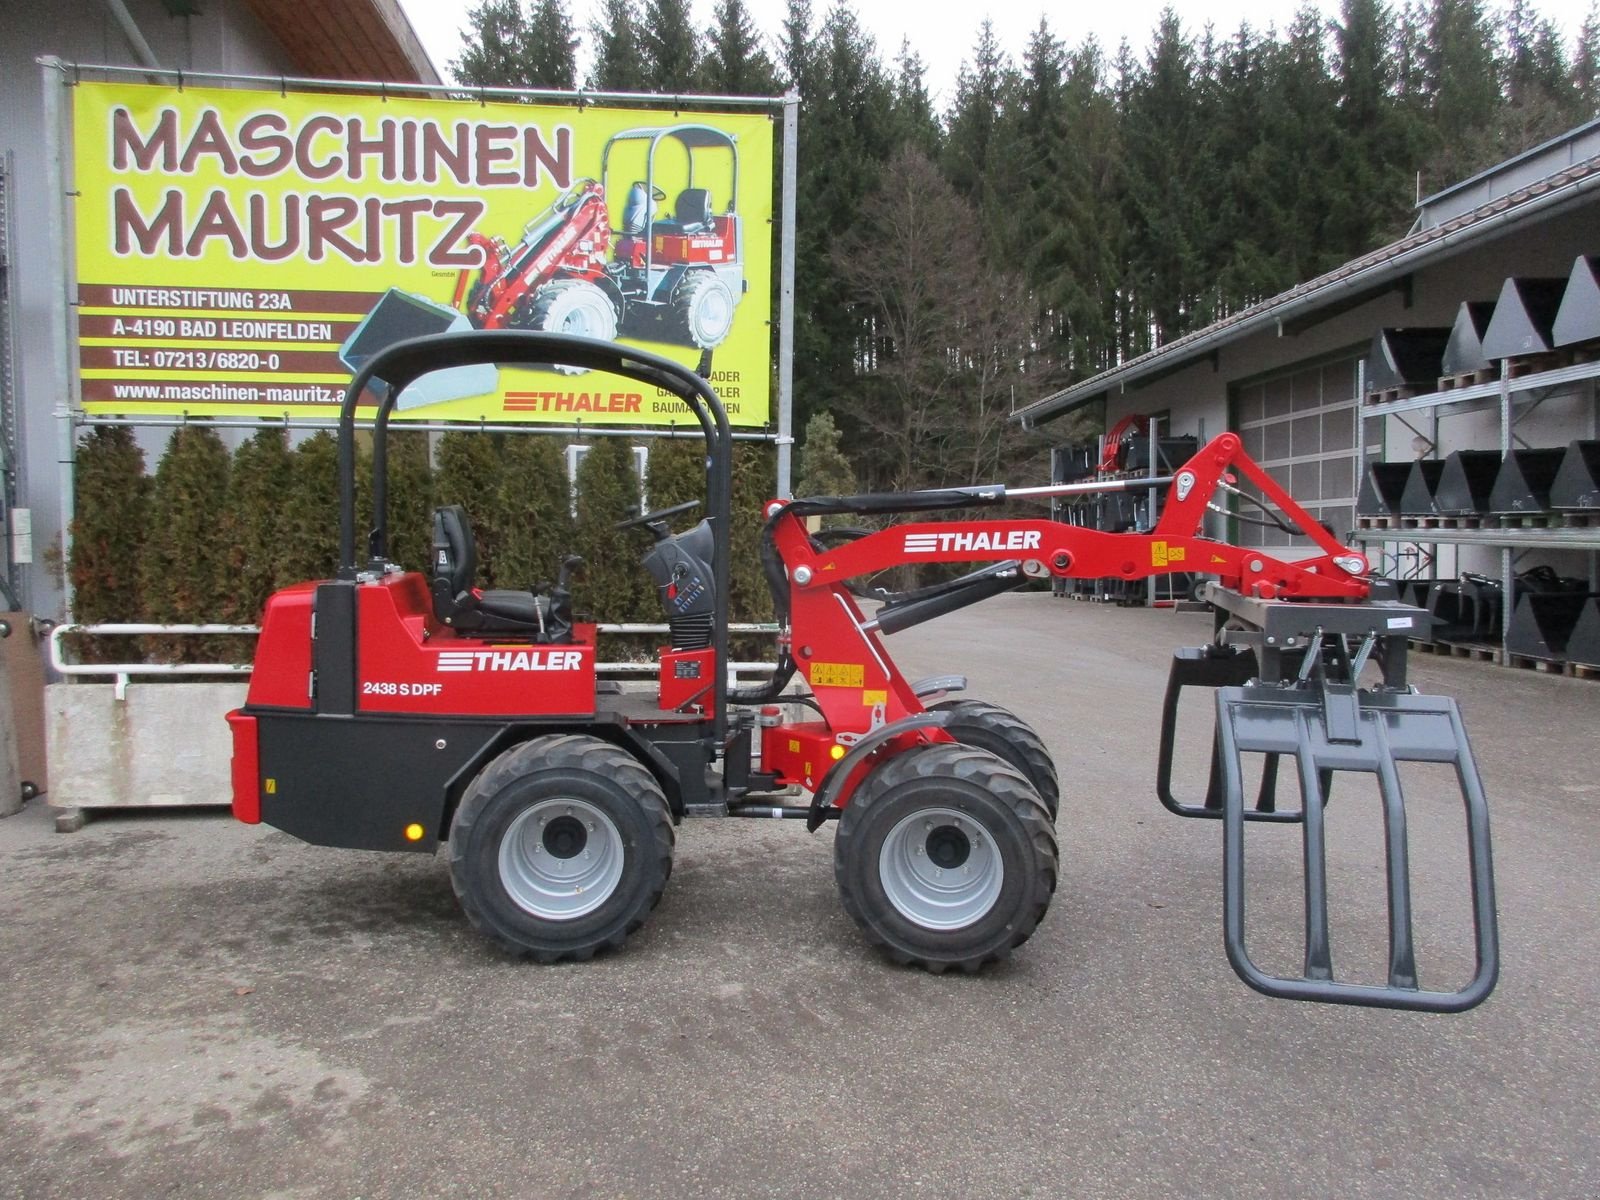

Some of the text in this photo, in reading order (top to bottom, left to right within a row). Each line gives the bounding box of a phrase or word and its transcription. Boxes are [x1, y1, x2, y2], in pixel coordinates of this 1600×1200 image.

[113, 108, 570, 188] MASCHINEN
[114, 188, 484, 265] MAURITZ
[112, 289, 292, 310] UNTERSTIFTUNG 23A
[112, 318, 332, 341] A-4190 BAD LEONFELDEN
[113, 350, 280, 370] TEL: 07213/6820-0
[536, 391, 643, 413] THALER
[937, 530, 1042, 551] THALER
[474, 651, 582, 671] THALER
[363, 682, 443, 696] 2438 S DPF
